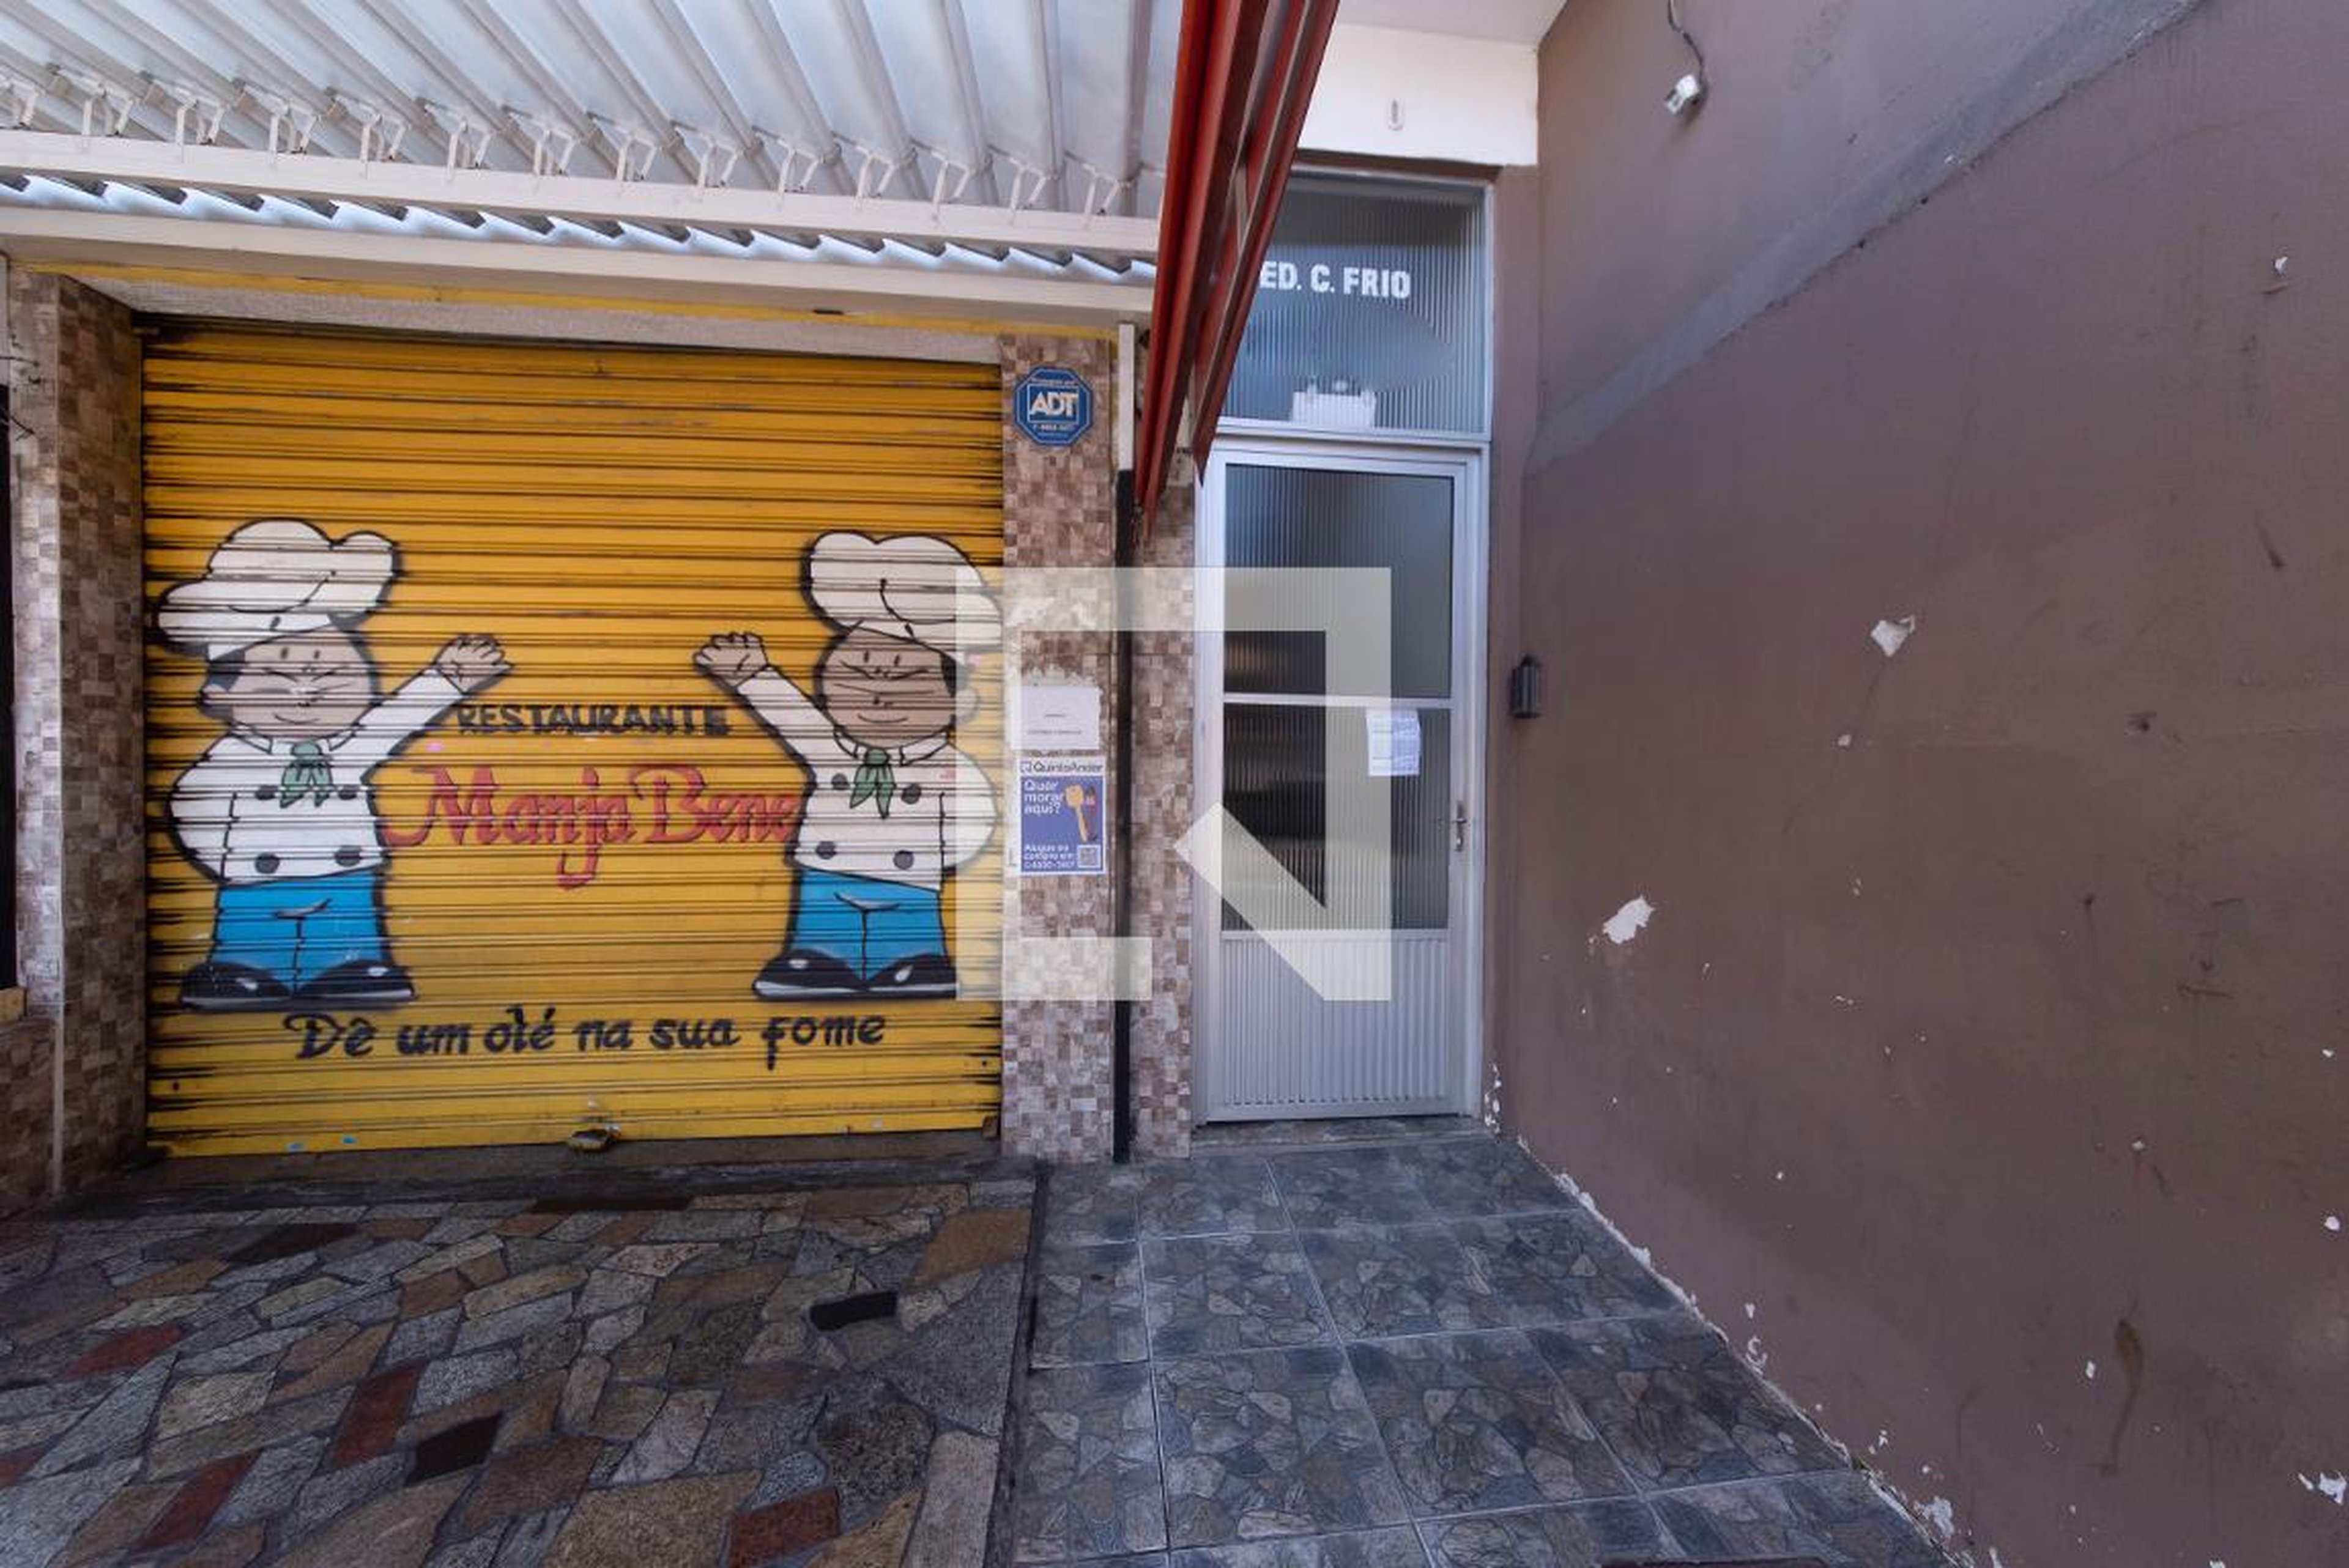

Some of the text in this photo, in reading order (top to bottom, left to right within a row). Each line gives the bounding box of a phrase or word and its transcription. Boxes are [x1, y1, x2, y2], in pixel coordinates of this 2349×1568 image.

[1259, 261, 1411, 299] ED. C. FRIO
[1028, 391, 1079, 418] ADT
[456, 704, 729, 735] RESTAURANTE
[1024, 793, 1064, 803] morar
[382, 763, 803, 890] Manja Bene
[283, 1003, 886, 1071] Dê um olé na sua fome
